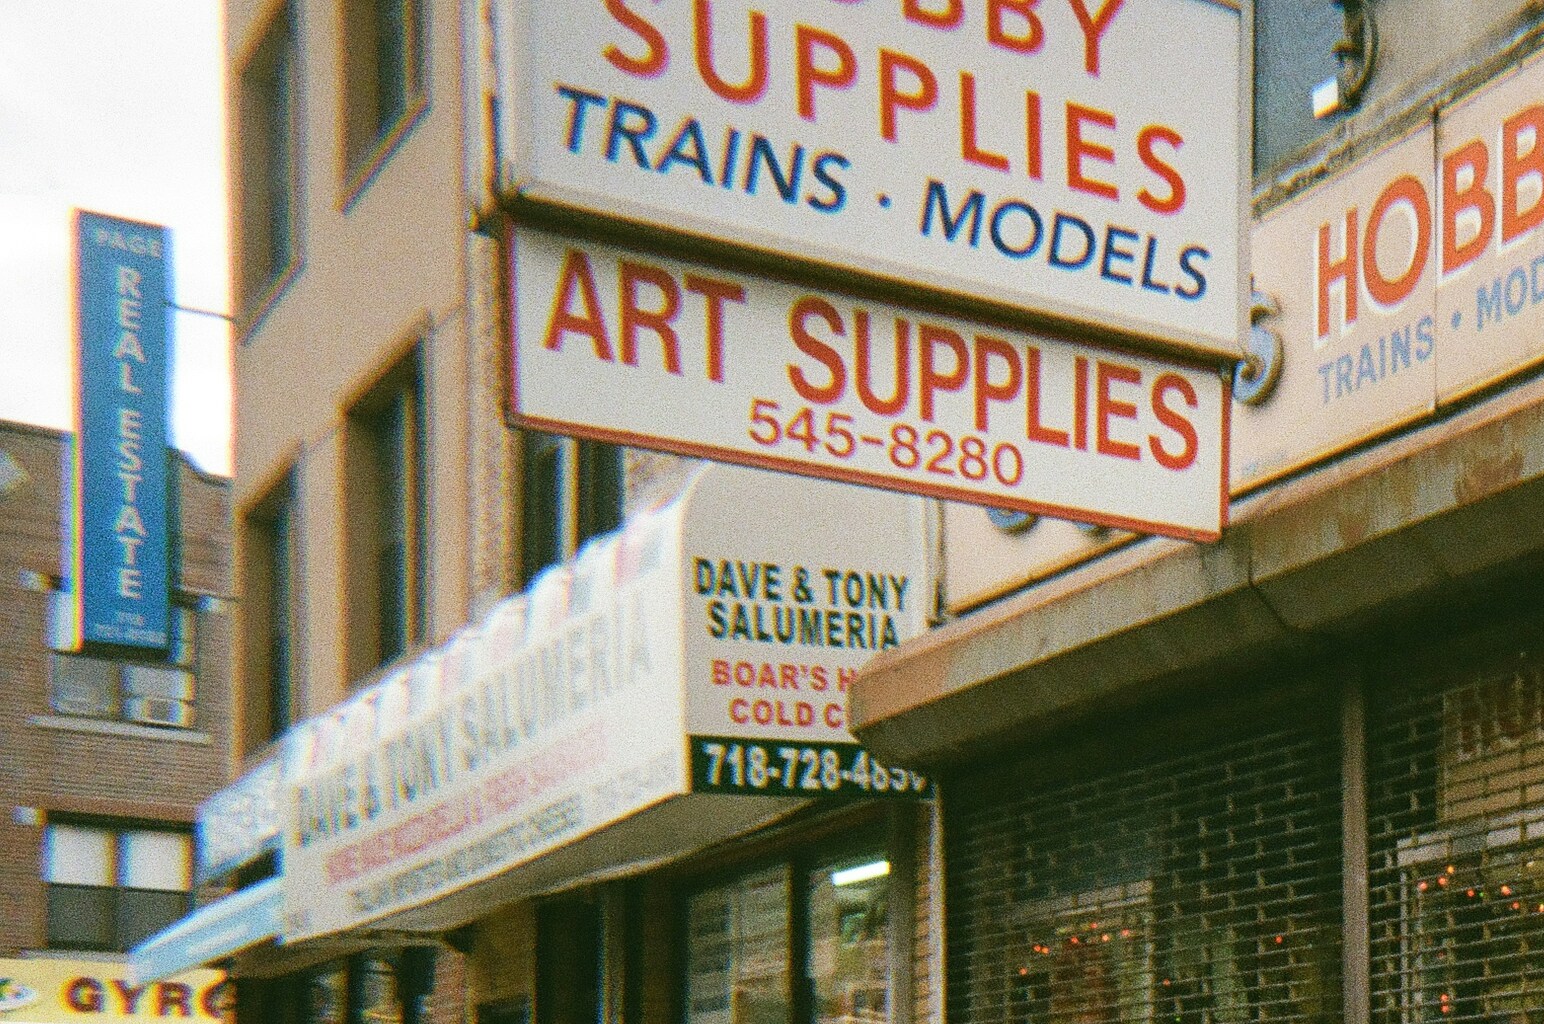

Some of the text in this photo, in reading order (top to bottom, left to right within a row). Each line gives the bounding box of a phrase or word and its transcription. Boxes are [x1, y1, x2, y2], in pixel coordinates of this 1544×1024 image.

[600, 0, 1188, 217] SUPPLIES
[556, 85, 1212, 301] TRAINS MODELS
[115, 265, 147, 396] REAL
[544, 251, 1200, 473] ART SUPPLIES
[1317, 314, 1436, 405] TRAINS
[748, 400, 1024, 487] 545-8280
[115, 408, 147, 601] ESTATE
[693, 556, 909, 612] DAVE & TONY
[707, 600, 900, 651] SALUMERIA
[711, 659, 829, 693] BOAR'S
[729, 697, 815, 729] COLD
